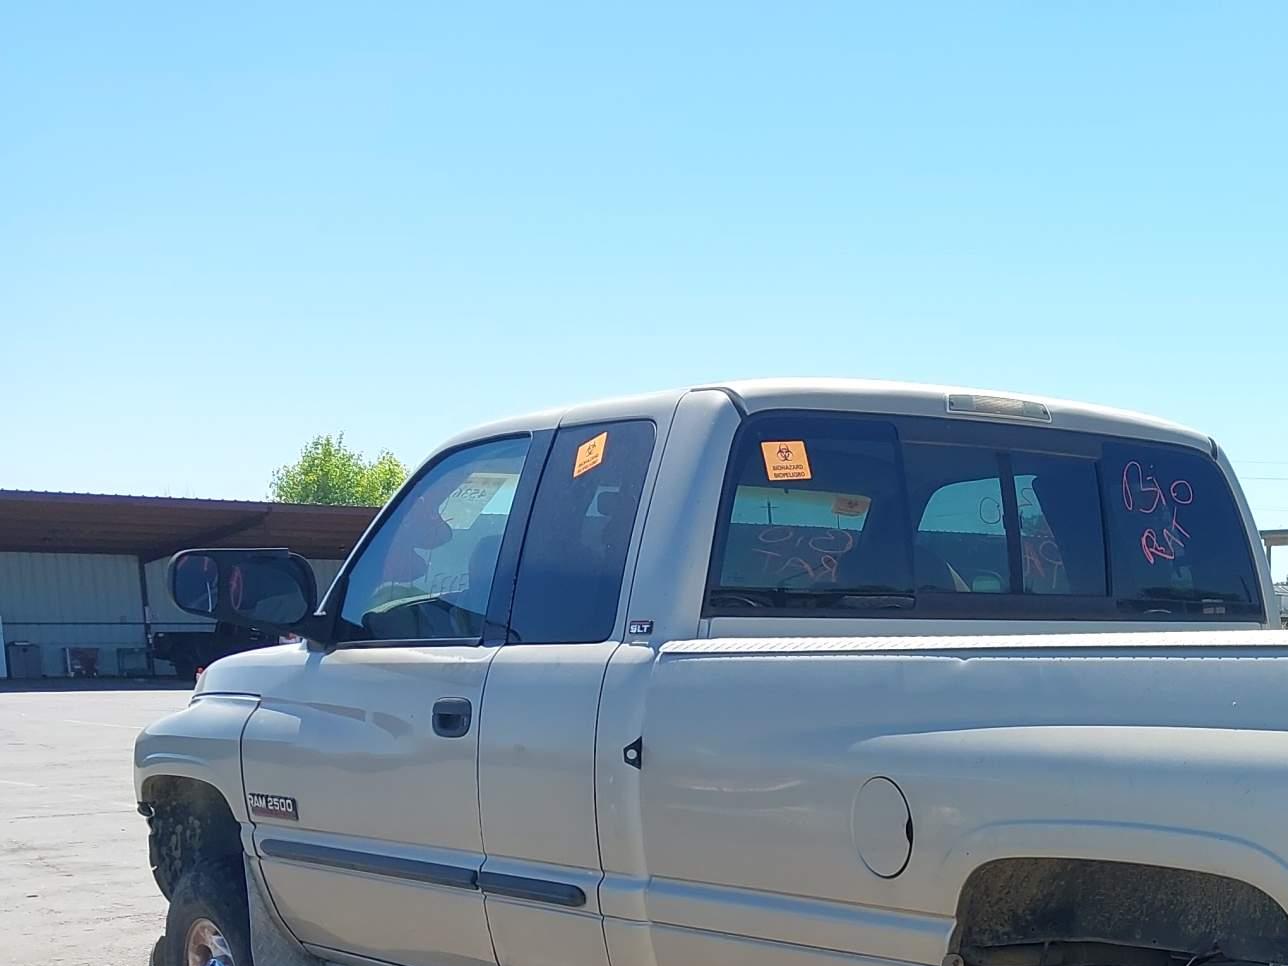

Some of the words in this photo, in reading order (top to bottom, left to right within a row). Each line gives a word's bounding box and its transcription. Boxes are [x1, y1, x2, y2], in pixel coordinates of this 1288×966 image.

[630, 624, 650, 633] SLT
[248, 794, 267, 809] RAM
[267, 797, 293, 812] 2500
